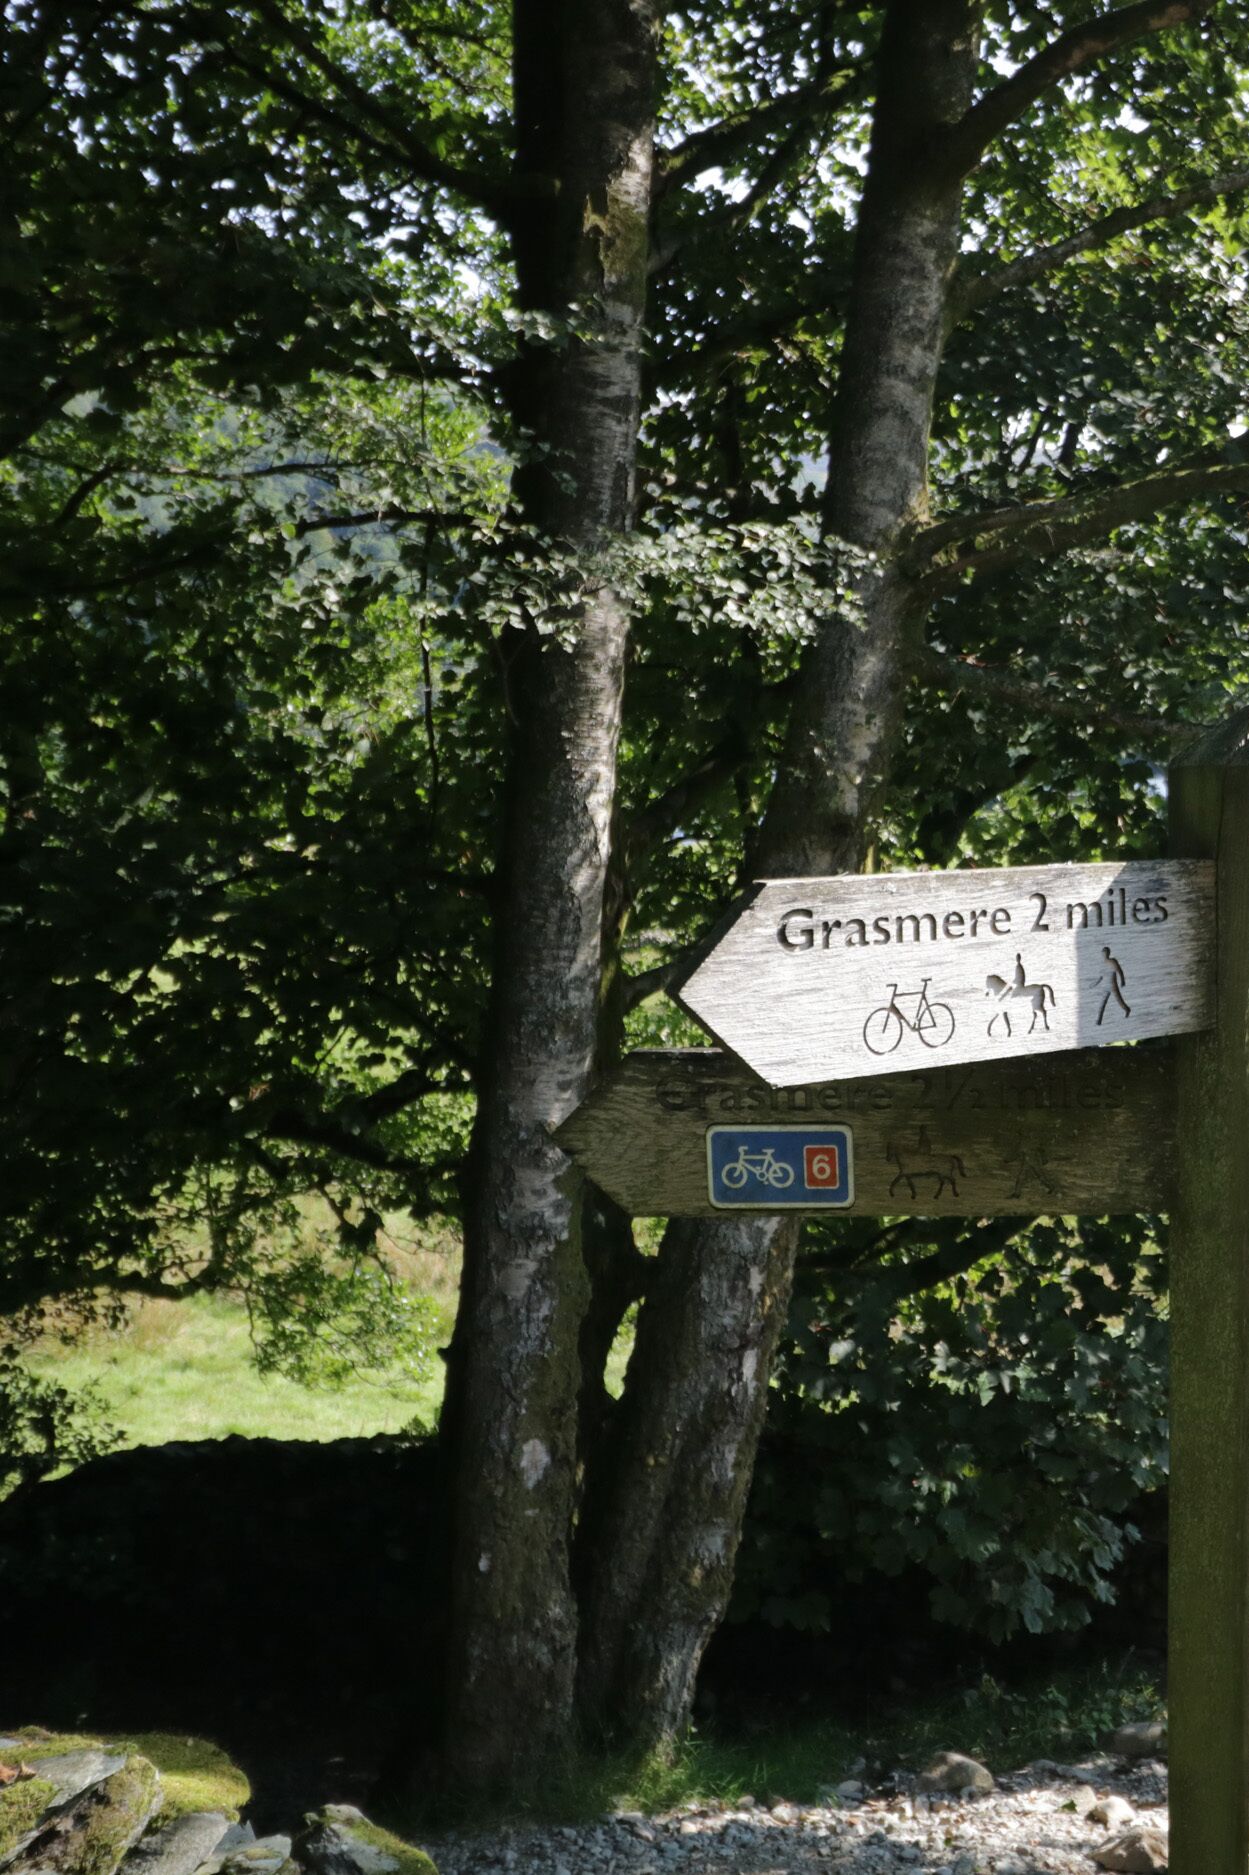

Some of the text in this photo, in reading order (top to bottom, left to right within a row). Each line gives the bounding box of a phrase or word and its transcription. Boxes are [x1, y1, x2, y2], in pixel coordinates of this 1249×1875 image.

[777, 888, 1169, 952] Grasmere 2 miles
[812, 1155, 830, 1180] 6
